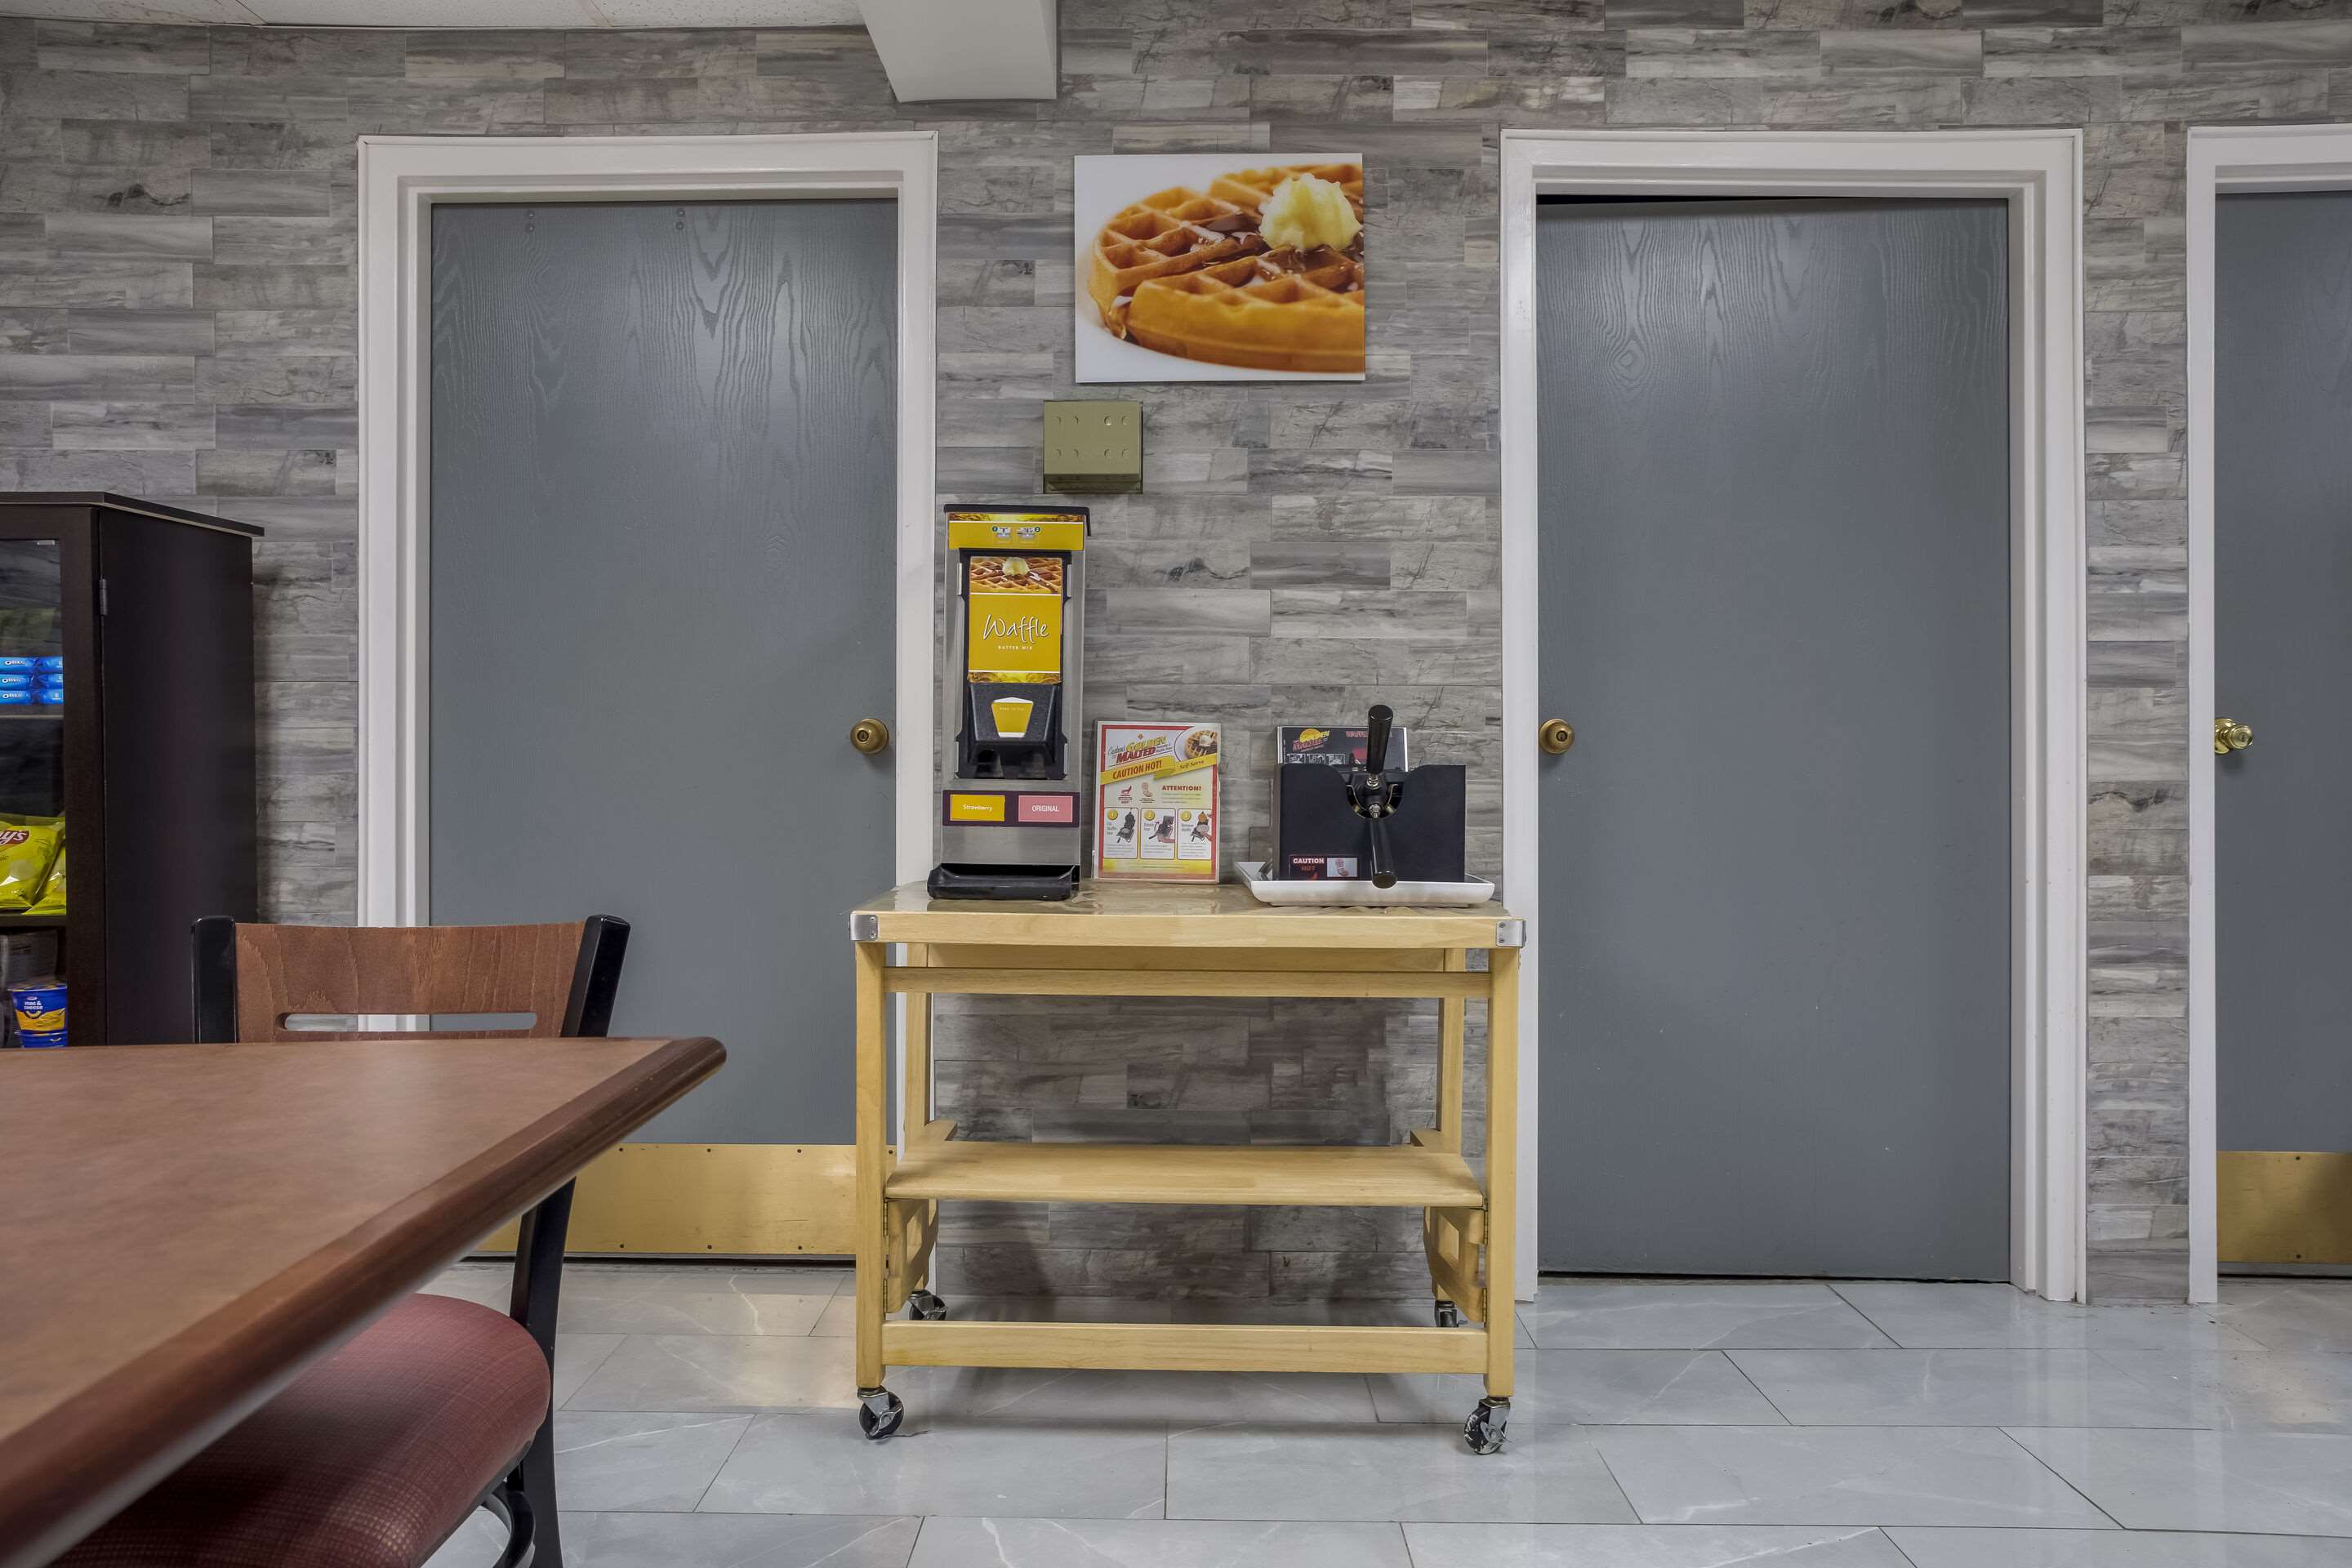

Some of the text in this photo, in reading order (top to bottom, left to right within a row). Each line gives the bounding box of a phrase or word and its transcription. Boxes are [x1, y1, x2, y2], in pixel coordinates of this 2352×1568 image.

[982, 613, 1050, 644] Waffle
[1116, 746, 1156, 763] MALTED
[1112, 760, 1162, 779] CAUTION HOT!
[962, 804, 1059, 813] Strawberry ORIGINAL
